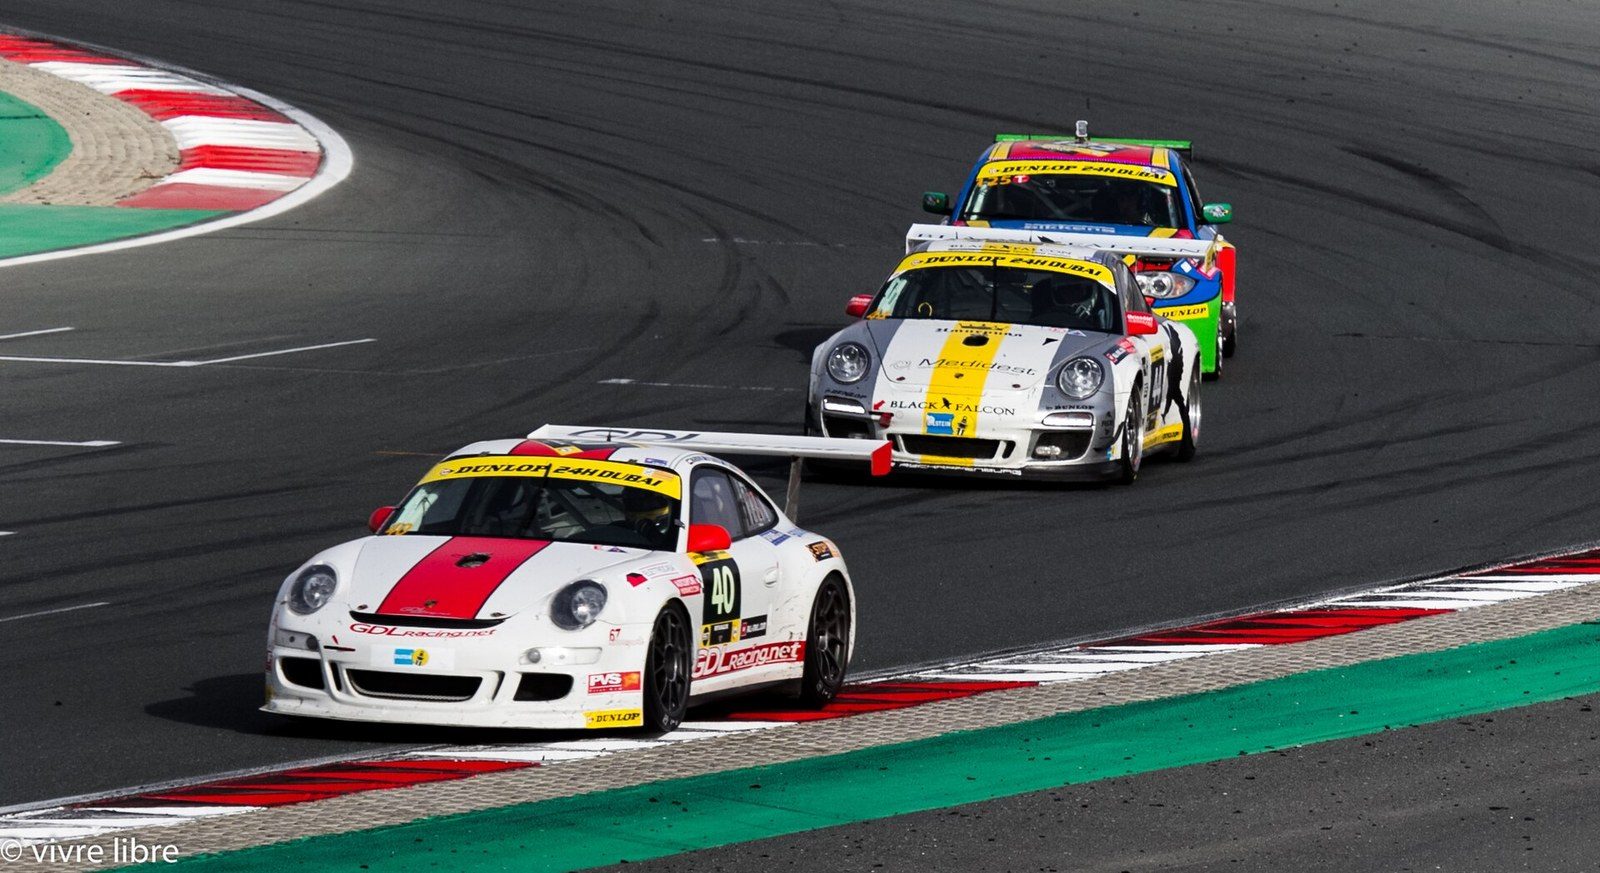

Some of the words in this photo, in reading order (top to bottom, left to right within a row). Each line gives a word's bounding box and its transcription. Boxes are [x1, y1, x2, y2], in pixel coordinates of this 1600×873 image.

[1003, 164, 1078, 174] DUNLOP
[1082, 166, 1116, 175] 24H
[1118, 168, 1167, 180] DUBAI
[923, 255, 1006, 264] DUNLOP
[1010, 258, 1048, 267] 24H
[1049, 260, 1102, 277] DUBAI
[1162, 307, 1207, 318] DUNLOP
[919, 358, 1037, 377] Medidest
[890, 400, 938, 410] BLACK
[955, 404, 1016, 416] FALCON
[455, 464, 547, 474] DUNLOP
[553, 465, 601, 477] 24H
[599, 469, 664, 487] DUBAI
[711, 565, 736, 615] 40
[609, 628, 622, 642] 67
[589, 673, 622, 687] PVS
[596, 712, 640, 723] DUNLOP
